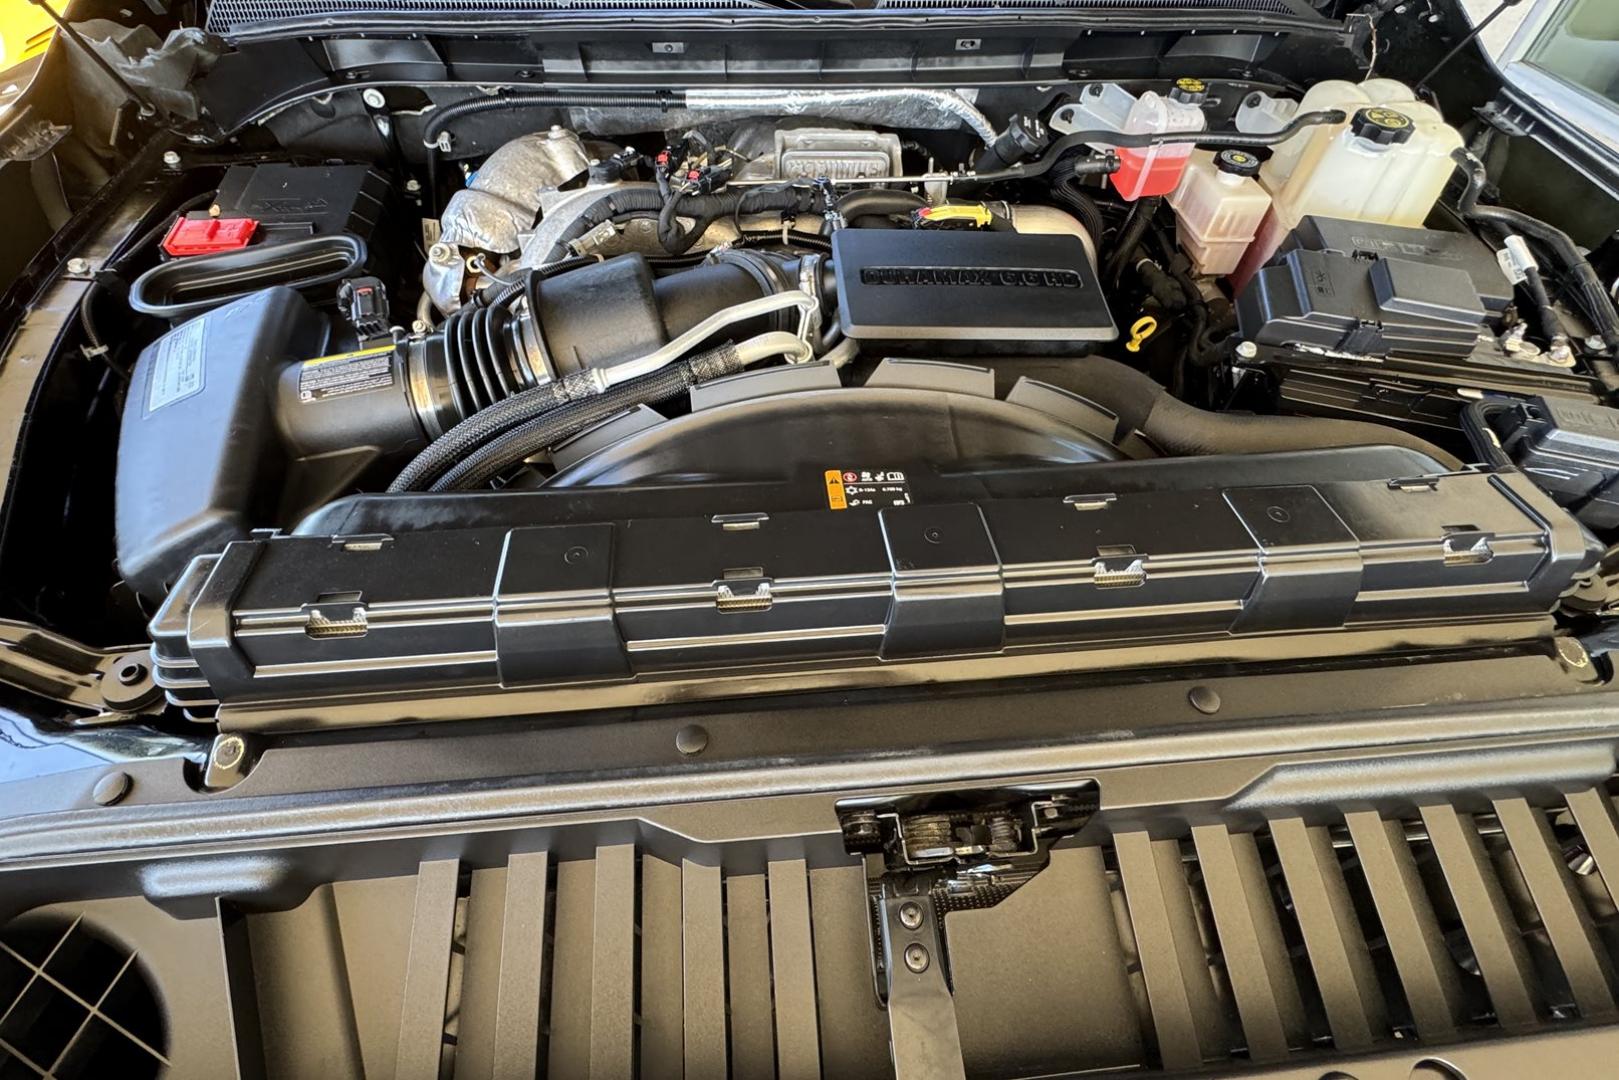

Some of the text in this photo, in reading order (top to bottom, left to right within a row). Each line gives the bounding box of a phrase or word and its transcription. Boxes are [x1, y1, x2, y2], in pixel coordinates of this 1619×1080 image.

[863, 268, 1080, 287] DURAMAX 6.6 HD
